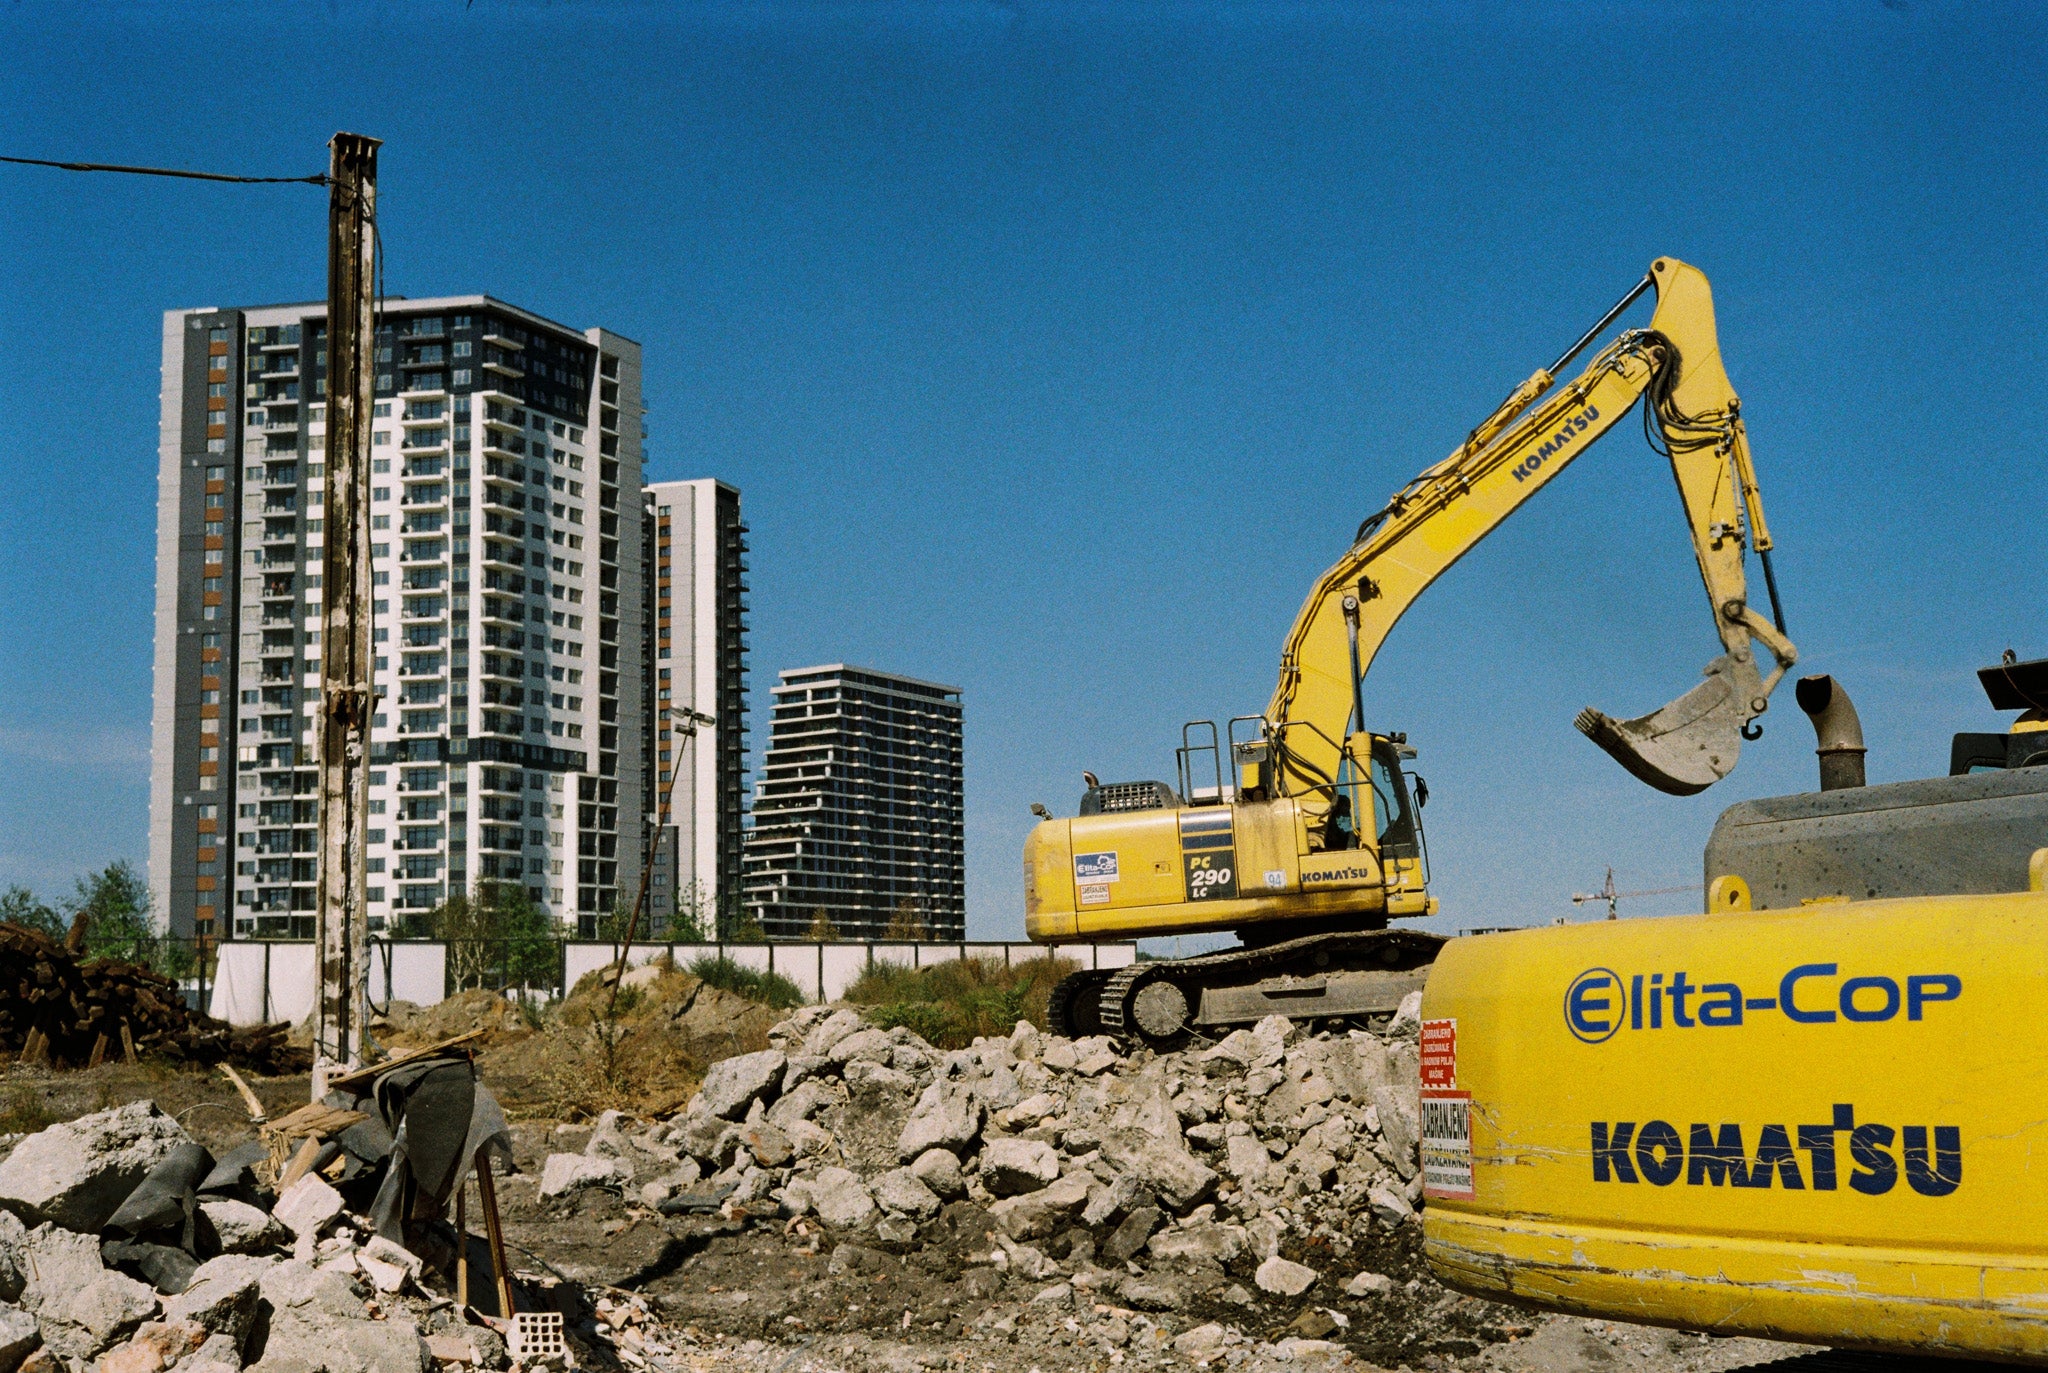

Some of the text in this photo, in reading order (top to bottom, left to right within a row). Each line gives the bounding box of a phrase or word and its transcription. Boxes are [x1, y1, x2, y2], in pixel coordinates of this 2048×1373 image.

[1512, 404, 1600, 483] KOMATSU
[1190, 856, 1211, 869] PC
[1191, 868, 1231, 887] 290
[1268, 873, 1281, 886] 94
[1302, 866, 1368, 883] KOMATSU
[1192, 887, 1208, 898] LC
[1422, 1103, 1468, 1140] ZABRANJENO
[1591, 1104, 1962, 1197] KOMATSU
